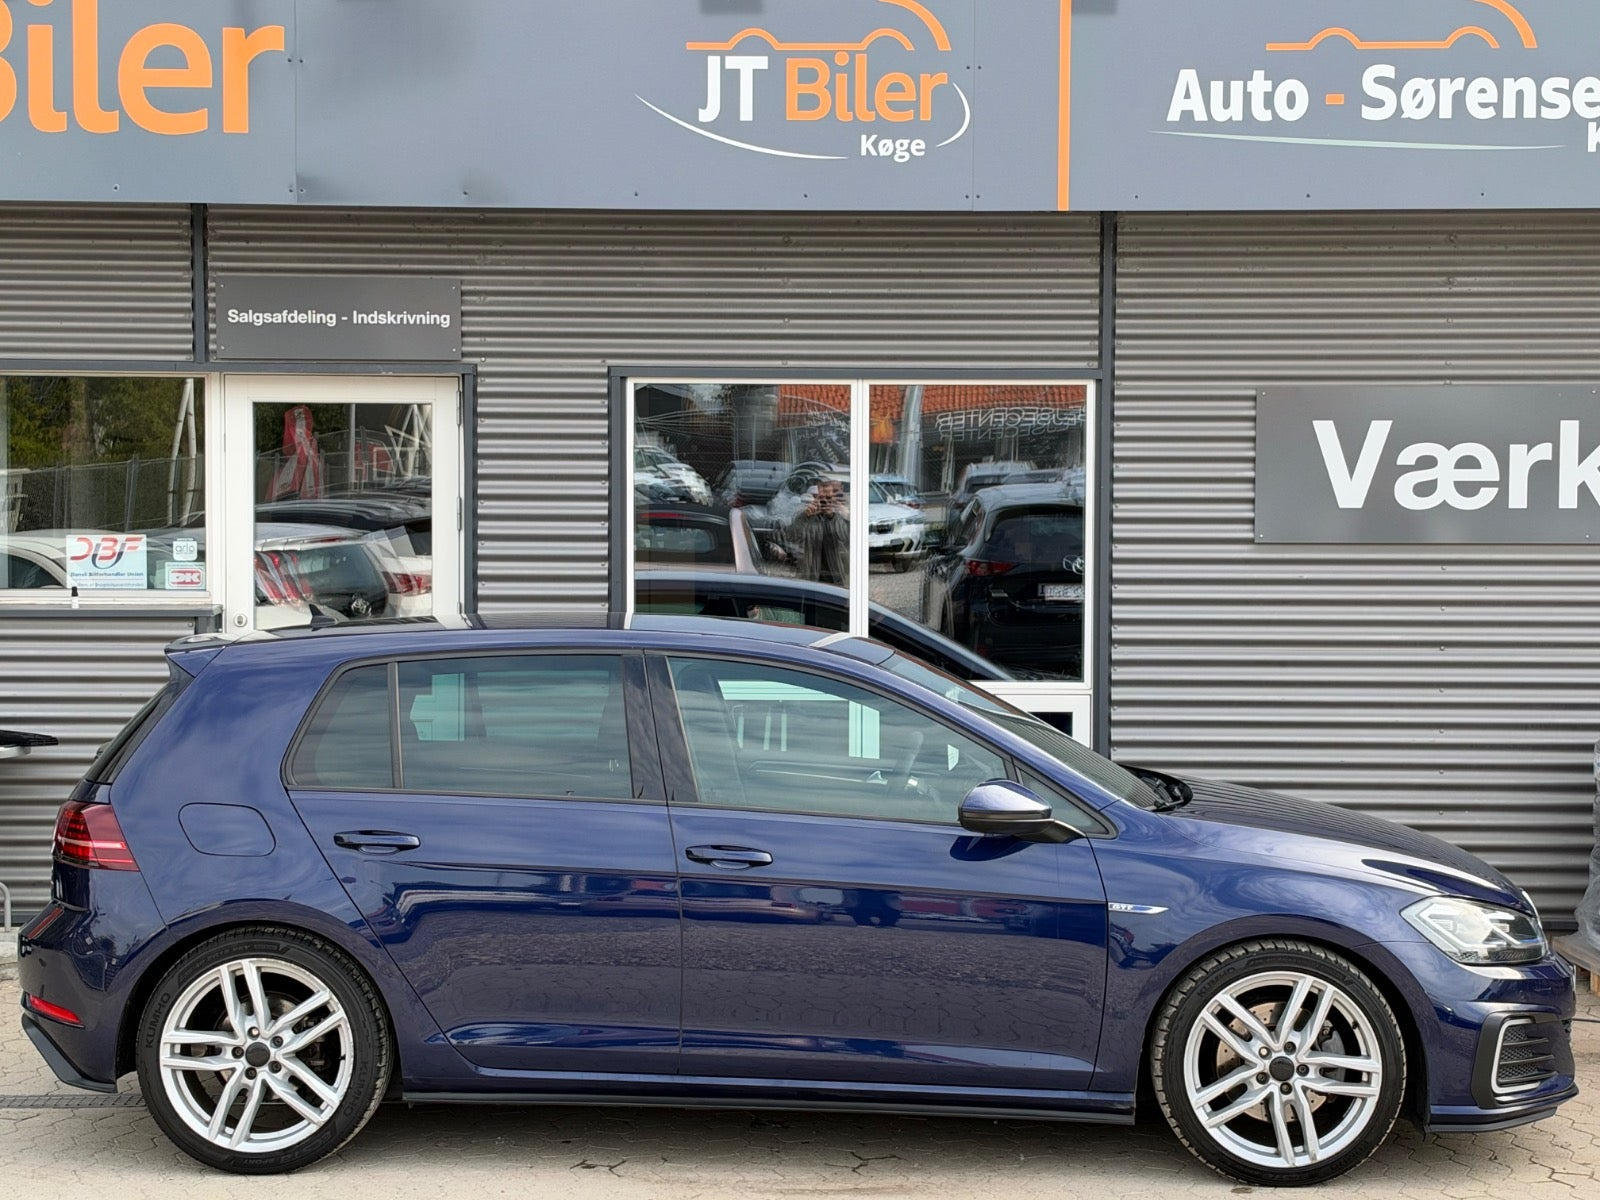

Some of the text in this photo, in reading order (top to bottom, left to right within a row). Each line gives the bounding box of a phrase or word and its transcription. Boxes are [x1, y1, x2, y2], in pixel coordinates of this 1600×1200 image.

[0, 0, 284, 135] iler
[698, 51, 948, 122] JT Biler
[1166, 68, 1309, 121] Auto
[1361, 63, 1600, 120] Sørense
[860, 135, 926, 162] Køge
[227, 308, 337, 328] Salgsafdeling
[352, 309, 451, 328] Indskrivning
[1312, 419, 1600, 510] Værk
[145, 991, 171, 1049] KUMHO
